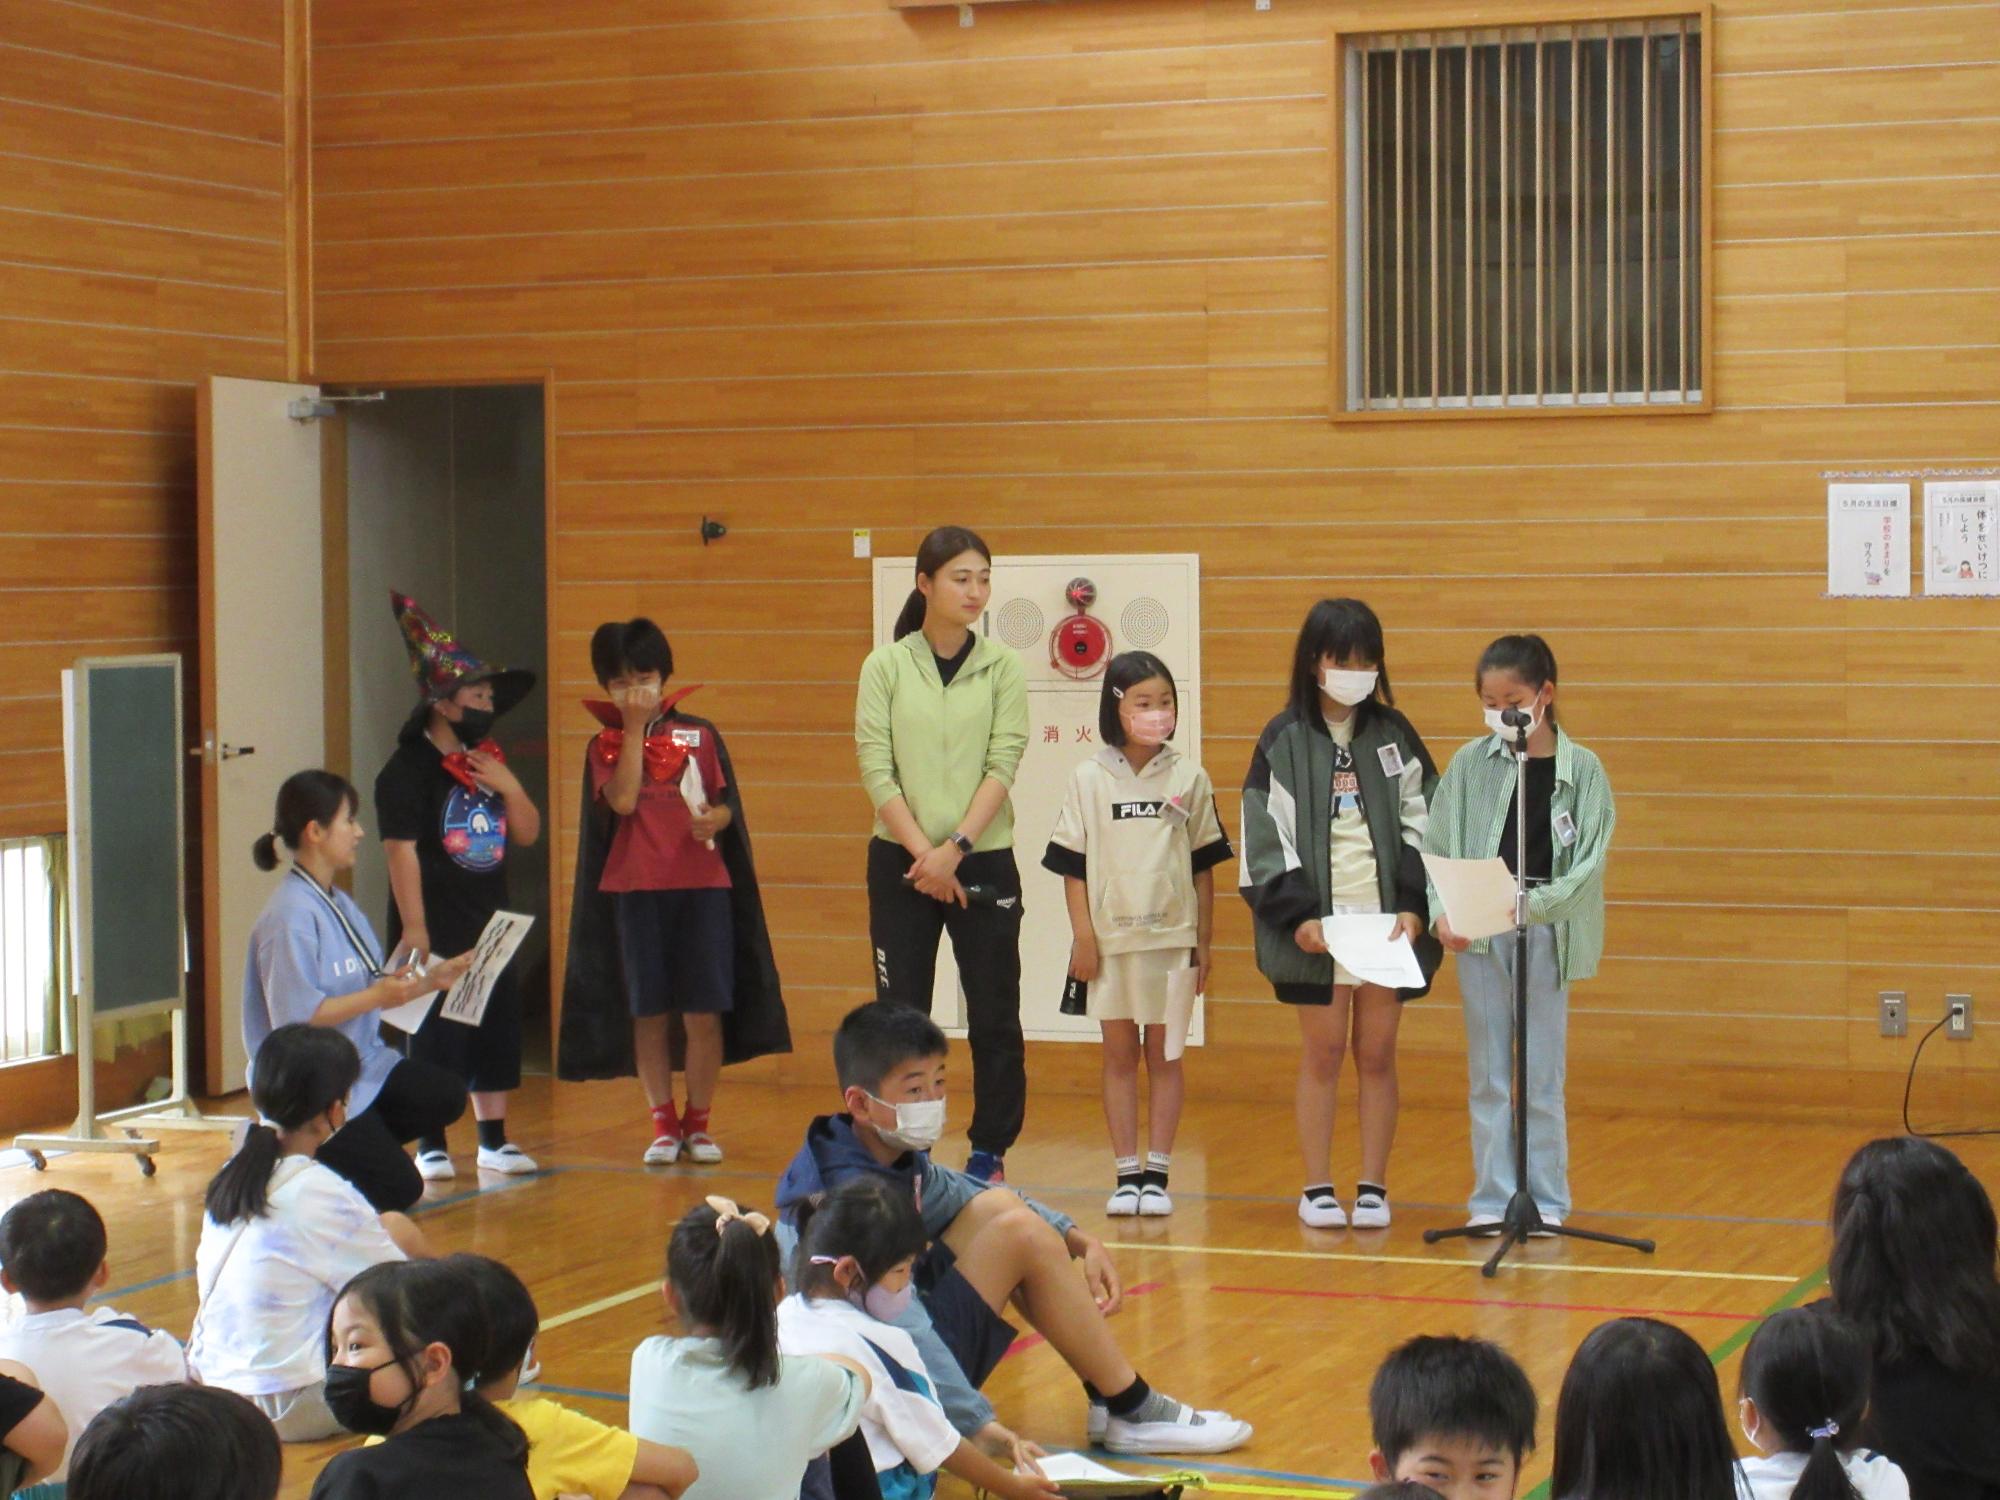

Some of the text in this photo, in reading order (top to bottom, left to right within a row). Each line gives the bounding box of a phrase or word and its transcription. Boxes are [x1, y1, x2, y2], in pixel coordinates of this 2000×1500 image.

[1960, 513, 1969, 544] しよう
[1120, 803, 1157, 818] FILA
